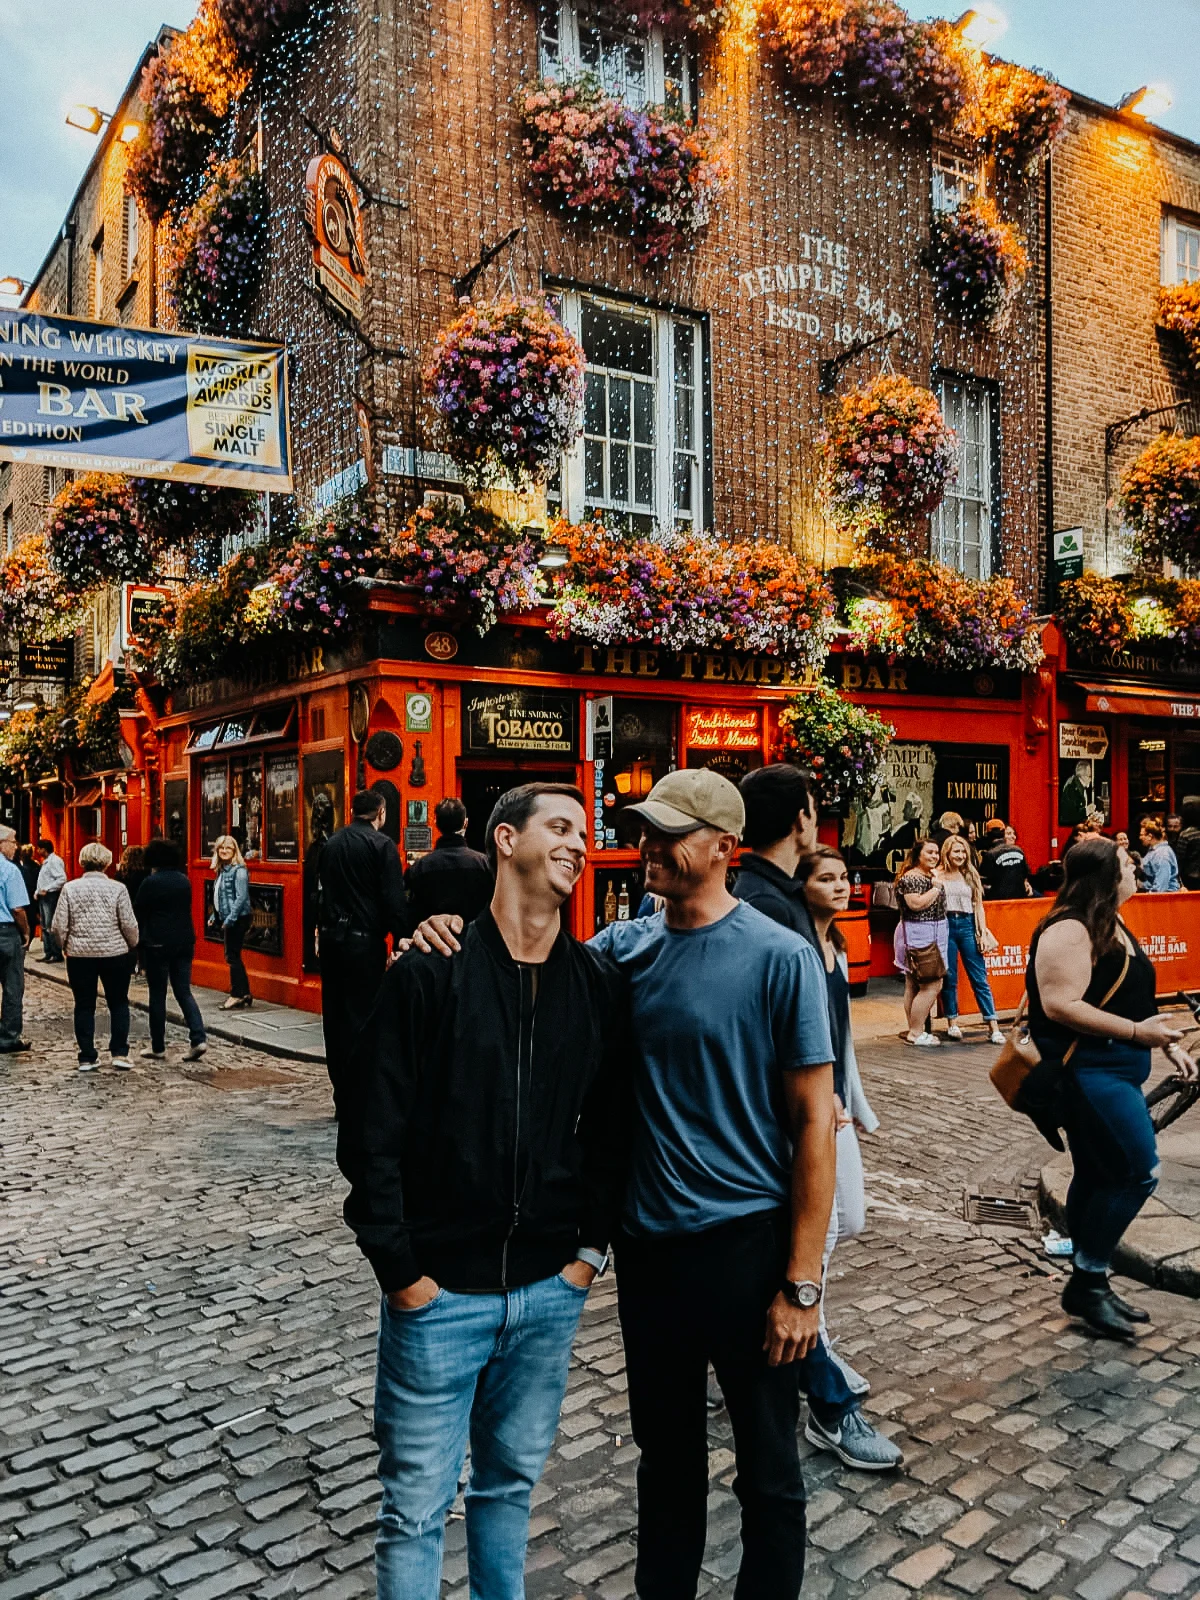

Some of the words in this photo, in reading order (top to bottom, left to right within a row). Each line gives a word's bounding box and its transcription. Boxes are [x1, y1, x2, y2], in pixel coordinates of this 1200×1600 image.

[800, 232, 850, 270] THE
[739, 264, 845, 299] TEMPLE
[855, 283, 902, 338] BAR
[69, 330, 180, 365] WHISKEY
[21, 354, 56, 374] THE
[63, 360, 129, 384] WORLD
[195, 359, 272, 380] WORLD
[195, 376, 272, 395] WHISKIES
[37, 381, 148, 424] BAR
[194, 388, 272, 410] AWARDS
[208, 411, 232, 422] BEST
[236, 414, 261, 426] IRISH
[2, 419, 82, 442] EDITION
[205, 422, 266, 442] SINGLE
[213, 438, 259, 456] MALT
[431, 636, 450, 652] 48
[287, 645, 325, 680] BAR
[575, 646, 660, 676] THE
[841, 664, 907, 690] BAR
[467, 693, 514, 712] Importers
[1171, 703, 1194, 716] THE
[509, 709, 527, 718] FINE
[691, 713, 756, 728] Traditional
[480, 712, 563, 744] TOBACCO
[689, 729, 719, 744] Irish
[724, 731, 758, 745] Music
[892, 764, 920, 780] BAR
[976, 763, 998, 781] THE
[947, 782, 998, 800] EMPEROR
[985, 803, 998, 818] OF
[1151, 935, 1166, 945] THE
[1168, 942, 1188, 954] BAR
[1003, 945, 1022, 955] THE
[984, 955, 1023, 968] EMPLE
